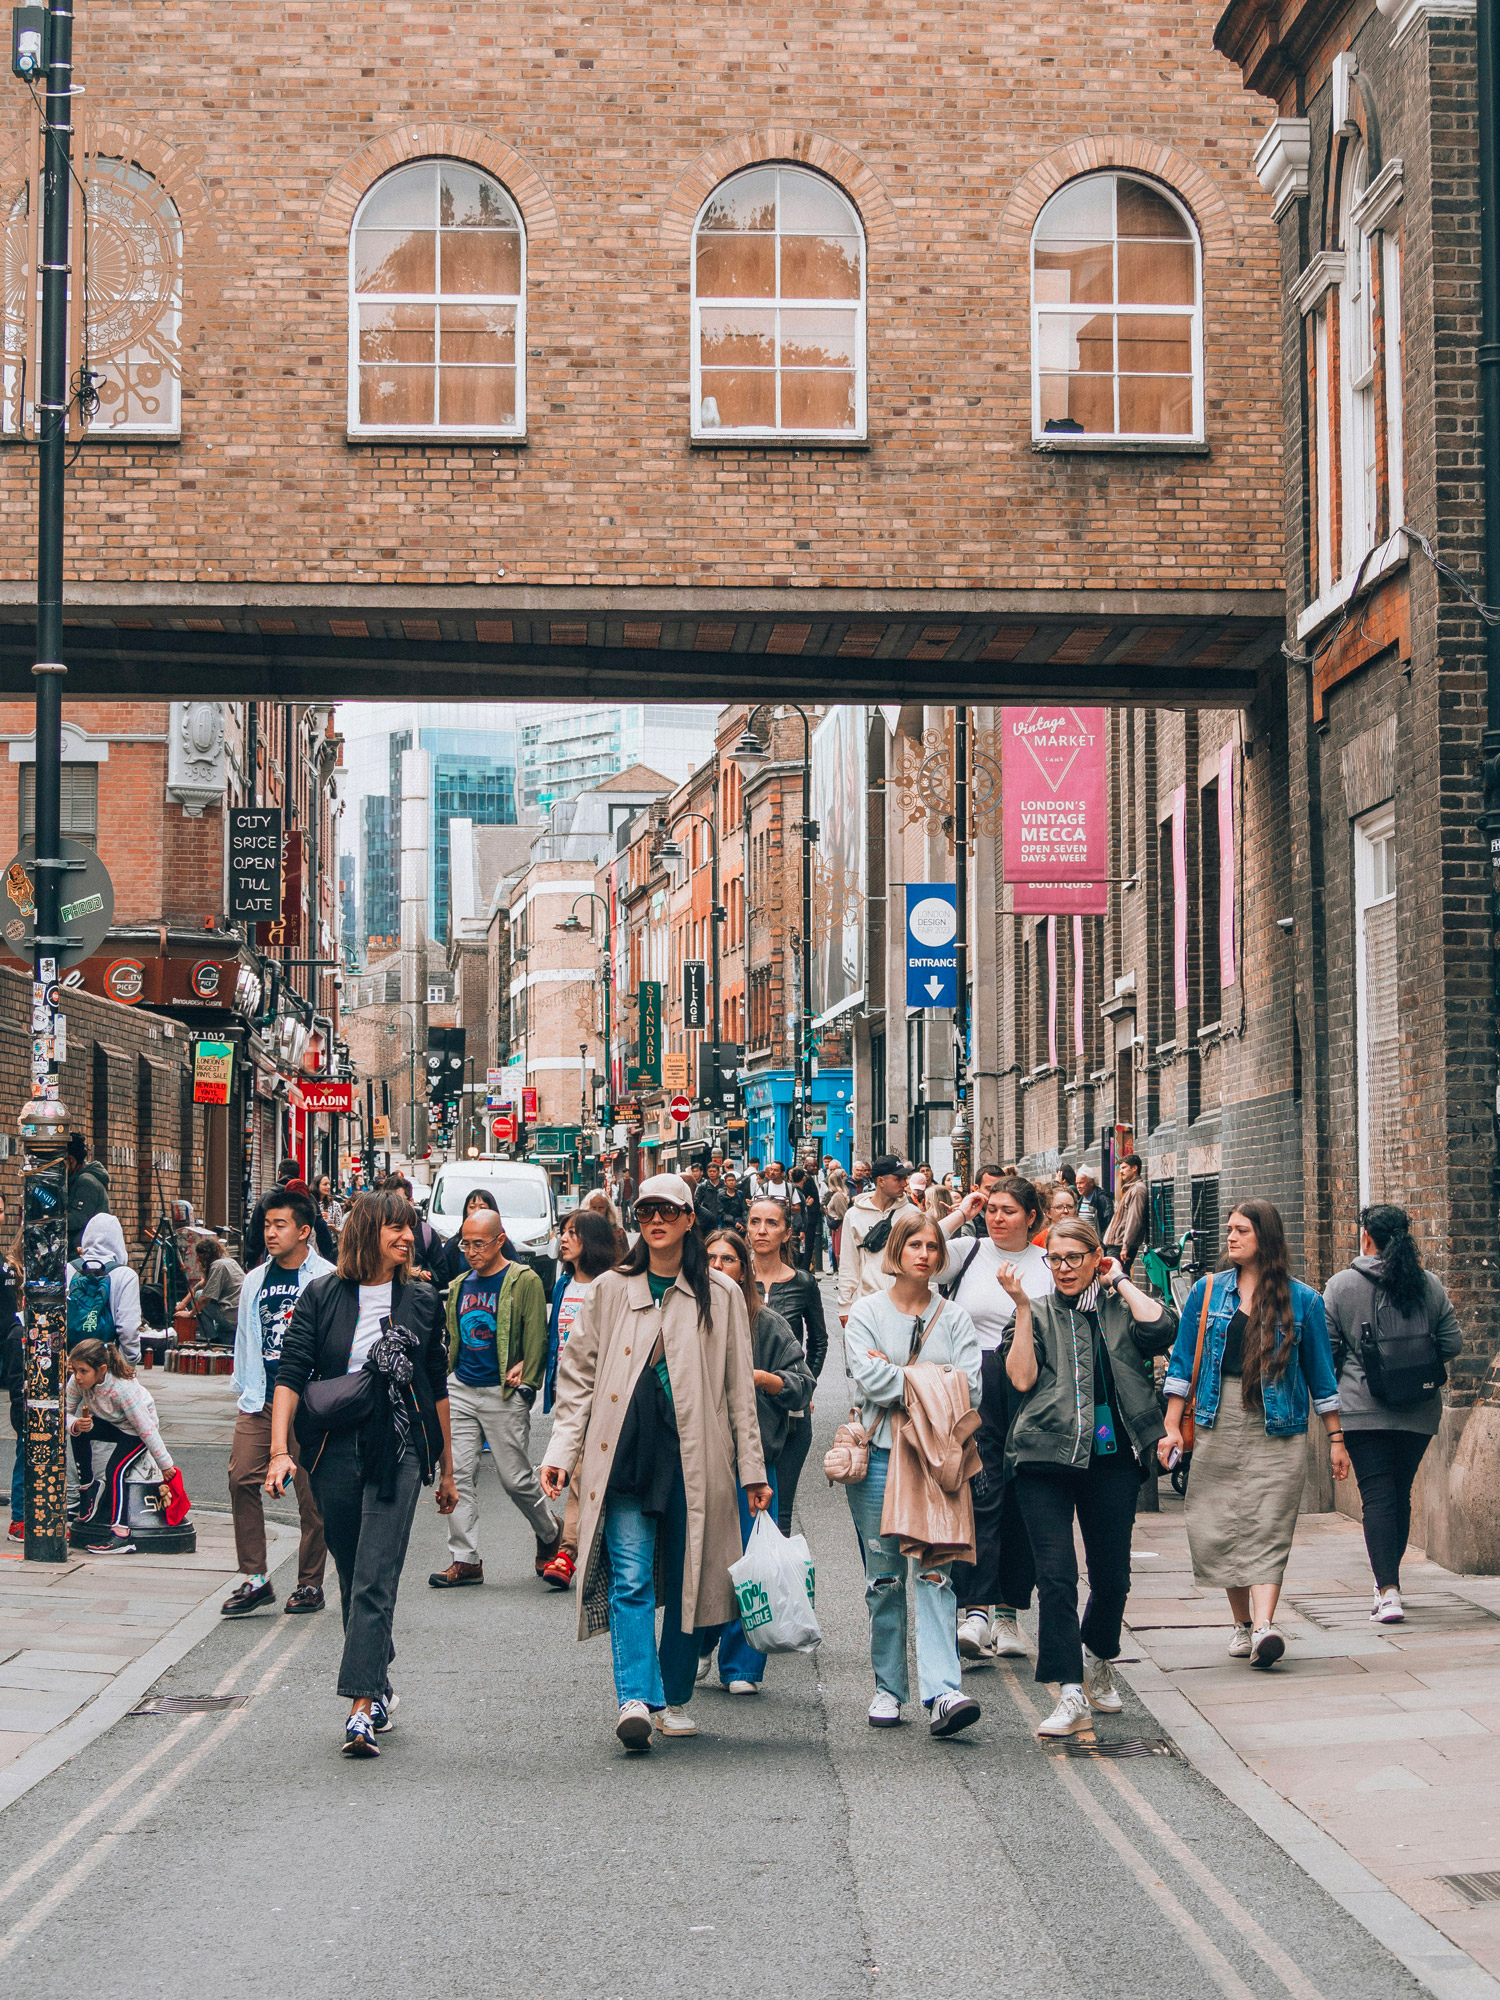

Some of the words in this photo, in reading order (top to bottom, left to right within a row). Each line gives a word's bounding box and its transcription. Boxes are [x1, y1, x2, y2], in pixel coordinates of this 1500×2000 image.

[1013, 716, 1066, 736] Vintage
[1034, 735, 1096, 747] MARKET
[1021, 801, 1086, 811] LONDON'S
[237, 815, 271, 829] CITY
[1021, 813, 1086, 825] VINTAGE
[1021, 827, 1087, 842] MECCA
[233, 836, 277, 849] SPICE
[1021, 844, 1051, 854] OPEN
[1053, 844, 1088, 854] SEVEN
[233, 857, 275, 870] OPEN
[1021, 854, 1047, 863] DAYS
[1049, 854, 1057, 863] A
[1059, 854, 1087, 863] WEEK
[239, 877, 271, 891] TILL
[235, 898, 273, 911] LATE
[690, 967, 698, 1023] VILLAGE
[646, 985, 655, 1065] STANDARD
[304, 1096, 348, 1106] ALADIN
